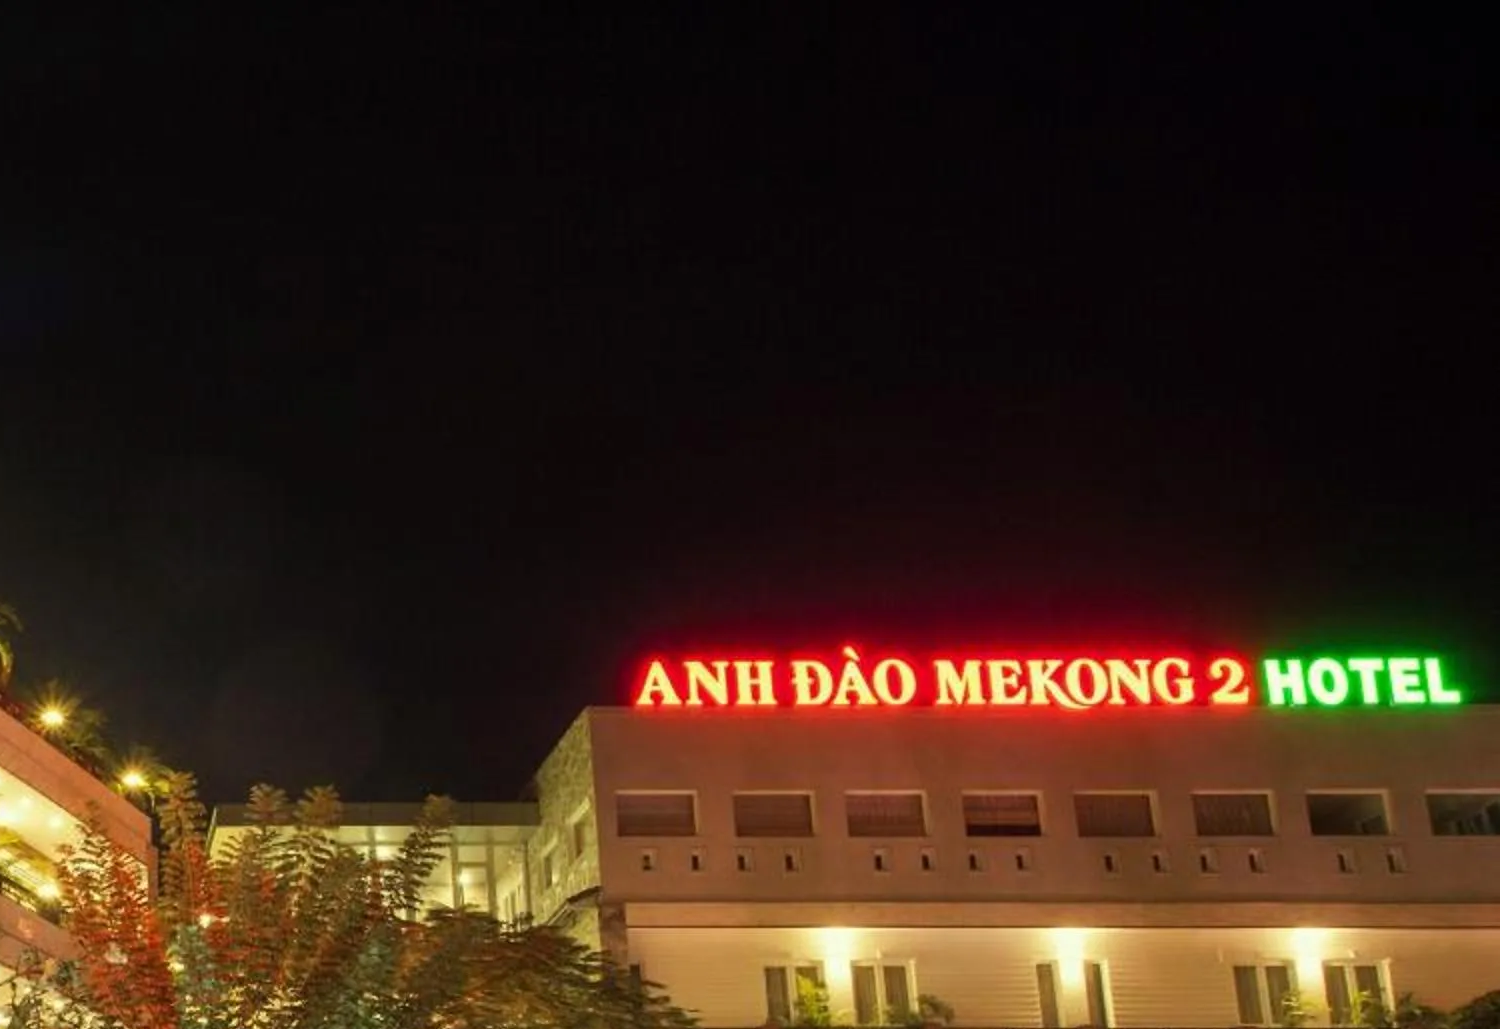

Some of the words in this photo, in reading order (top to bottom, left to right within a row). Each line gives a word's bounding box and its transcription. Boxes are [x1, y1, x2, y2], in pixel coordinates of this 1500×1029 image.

[636, 660, 777, 706] ANH
[791, 645, 917, 706] ĐÀO
[933, 657, 1195, 710] MEKONG
[1209, 657, 1250, 705] 2
[1263, 657, 1461, 706] HOTEL
